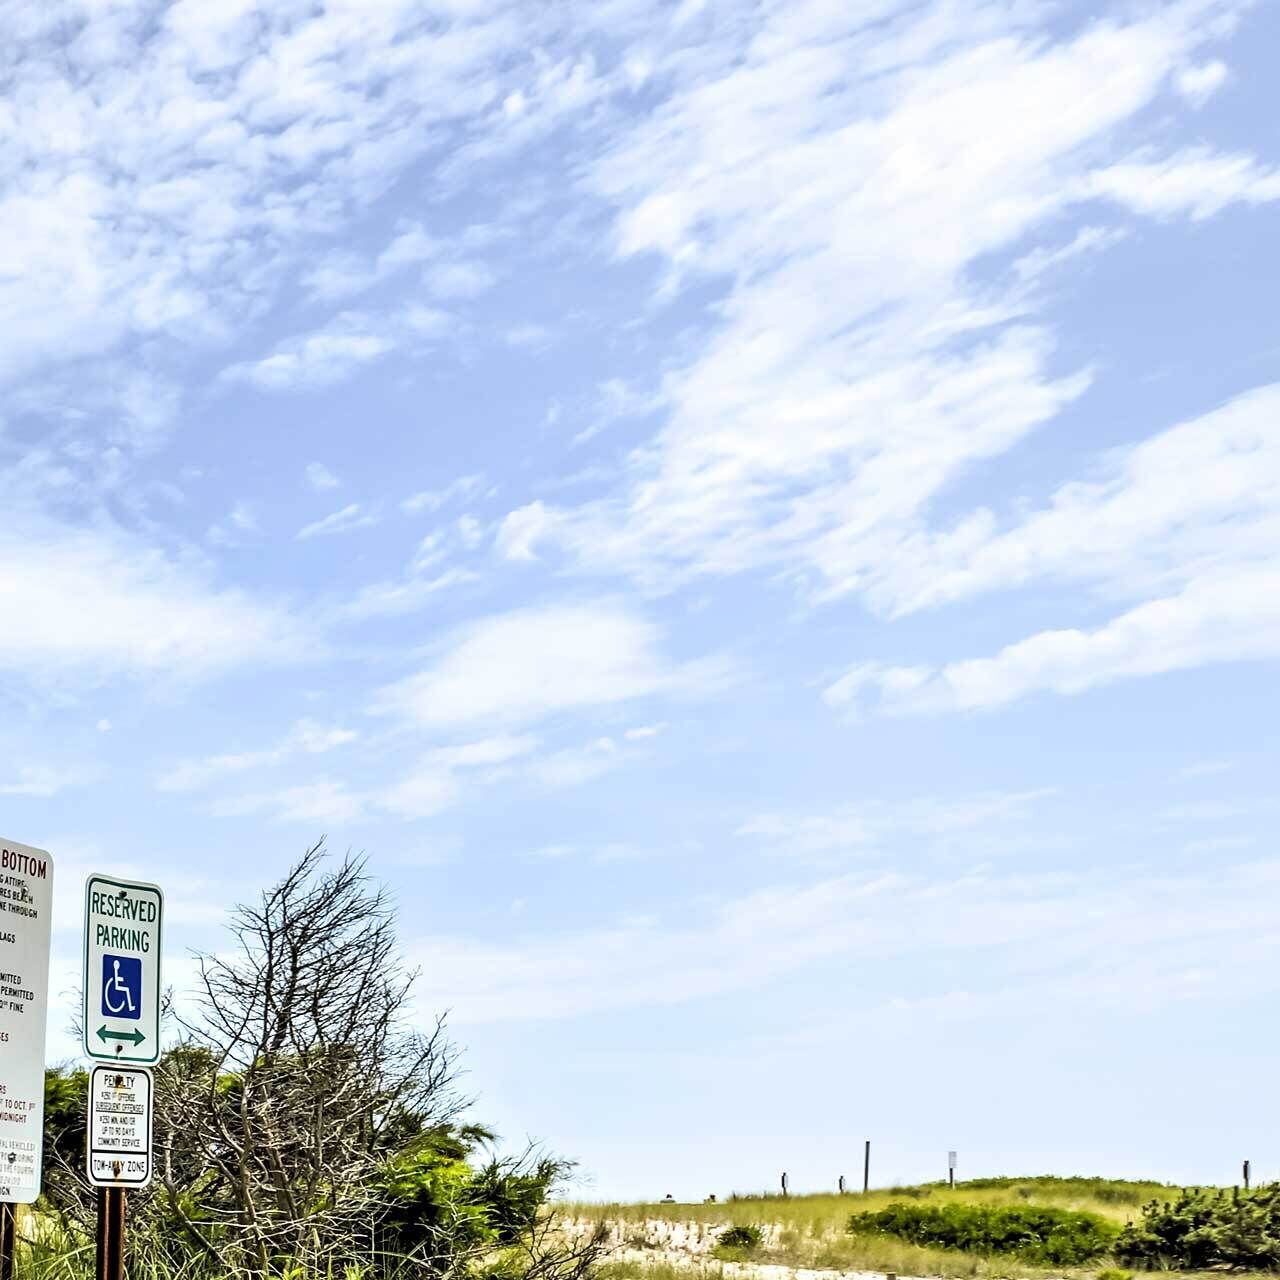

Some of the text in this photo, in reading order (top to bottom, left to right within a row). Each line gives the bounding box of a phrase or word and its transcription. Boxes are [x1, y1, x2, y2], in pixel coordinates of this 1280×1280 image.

[2, 850, 47, 879] BOTTOM
[8, 905, 38, 918] THROUGH
[92, 892, 156, 922] RESERVED
[97, 924, 149, 952] PARKING
[1, 986, 34, 1000] PERMITTED
[9, 1001, 24, 1013] FINE
[128, 1161, 144, 1172] ZONE
